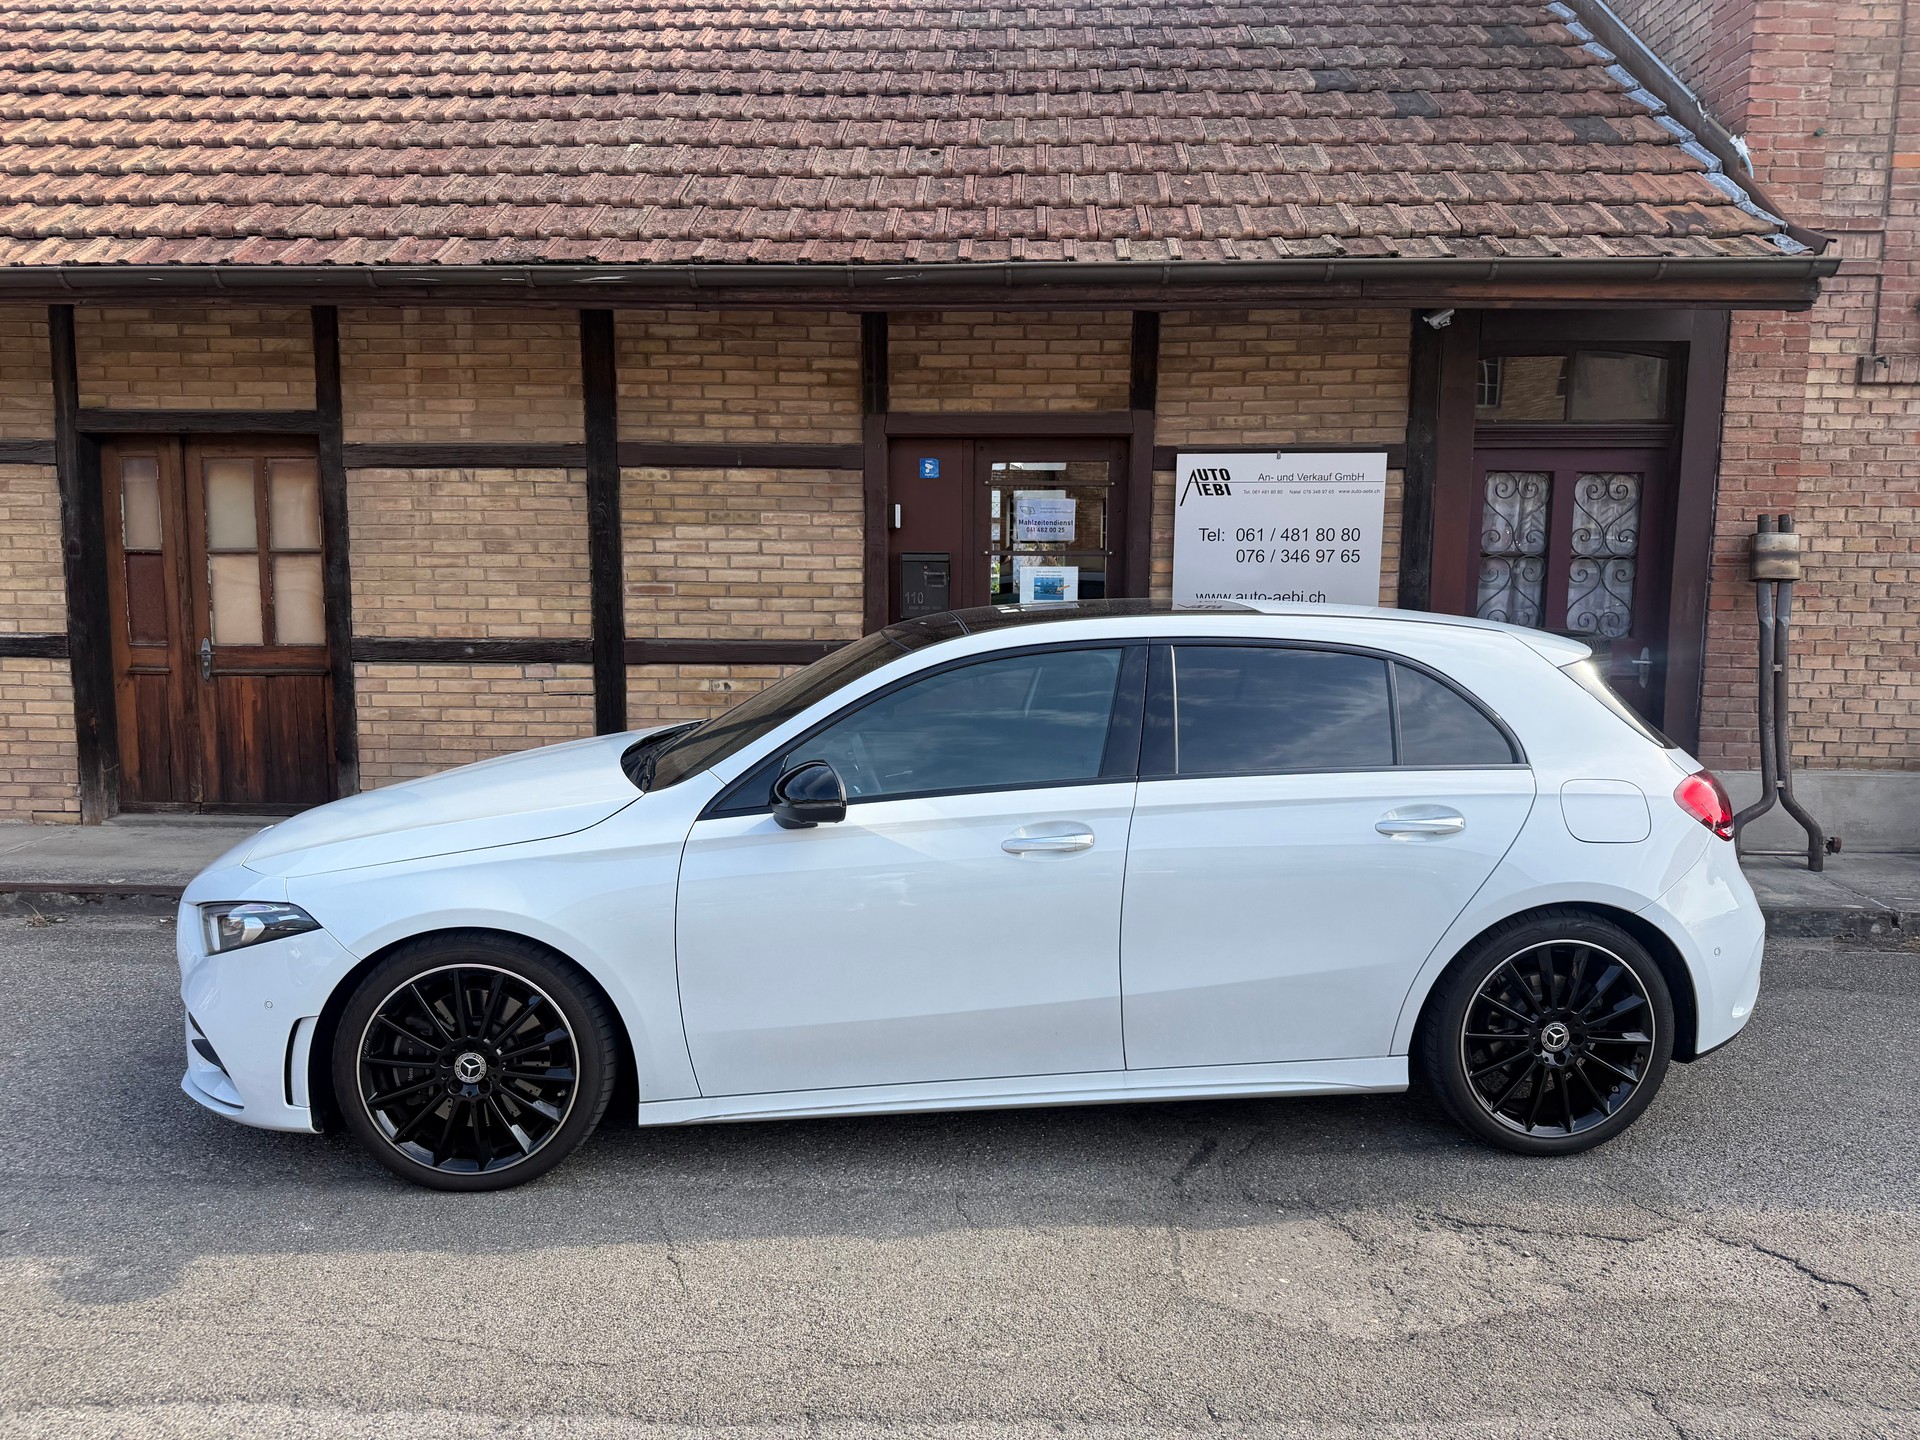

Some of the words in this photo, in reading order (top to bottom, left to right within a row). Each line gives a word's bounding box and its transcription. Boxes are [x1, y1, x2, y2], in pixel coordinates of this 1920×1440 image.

[1257, 472, 1274, 482] An-
[1276, 473, 1294, 482] und
[1296, 472, 1333, 482] Verkauf
[1334, 472, 1365, 482] GmbH
[1198, 527, 1226, 542] Tel:
[1235, 527, 1264, 542] 061
[1269, 527, 1277, 542] /
[1280, 527, 1309, 542] 481
[1315, 527, 1336, 542] 80
[1340, 527, 1361, 542] 80
[1235, 549, 1265, 563] 076
[1269, 549, 1277, 563] /
[1280, 549, 1310, 563] 346
[1315, 549, 1336, 563] 97
[1340, 549, 1361, 563] 65
[904, 591, 924, 604] 110
[1195, 590, 1326, 603] wwwauto-aebi.ch
